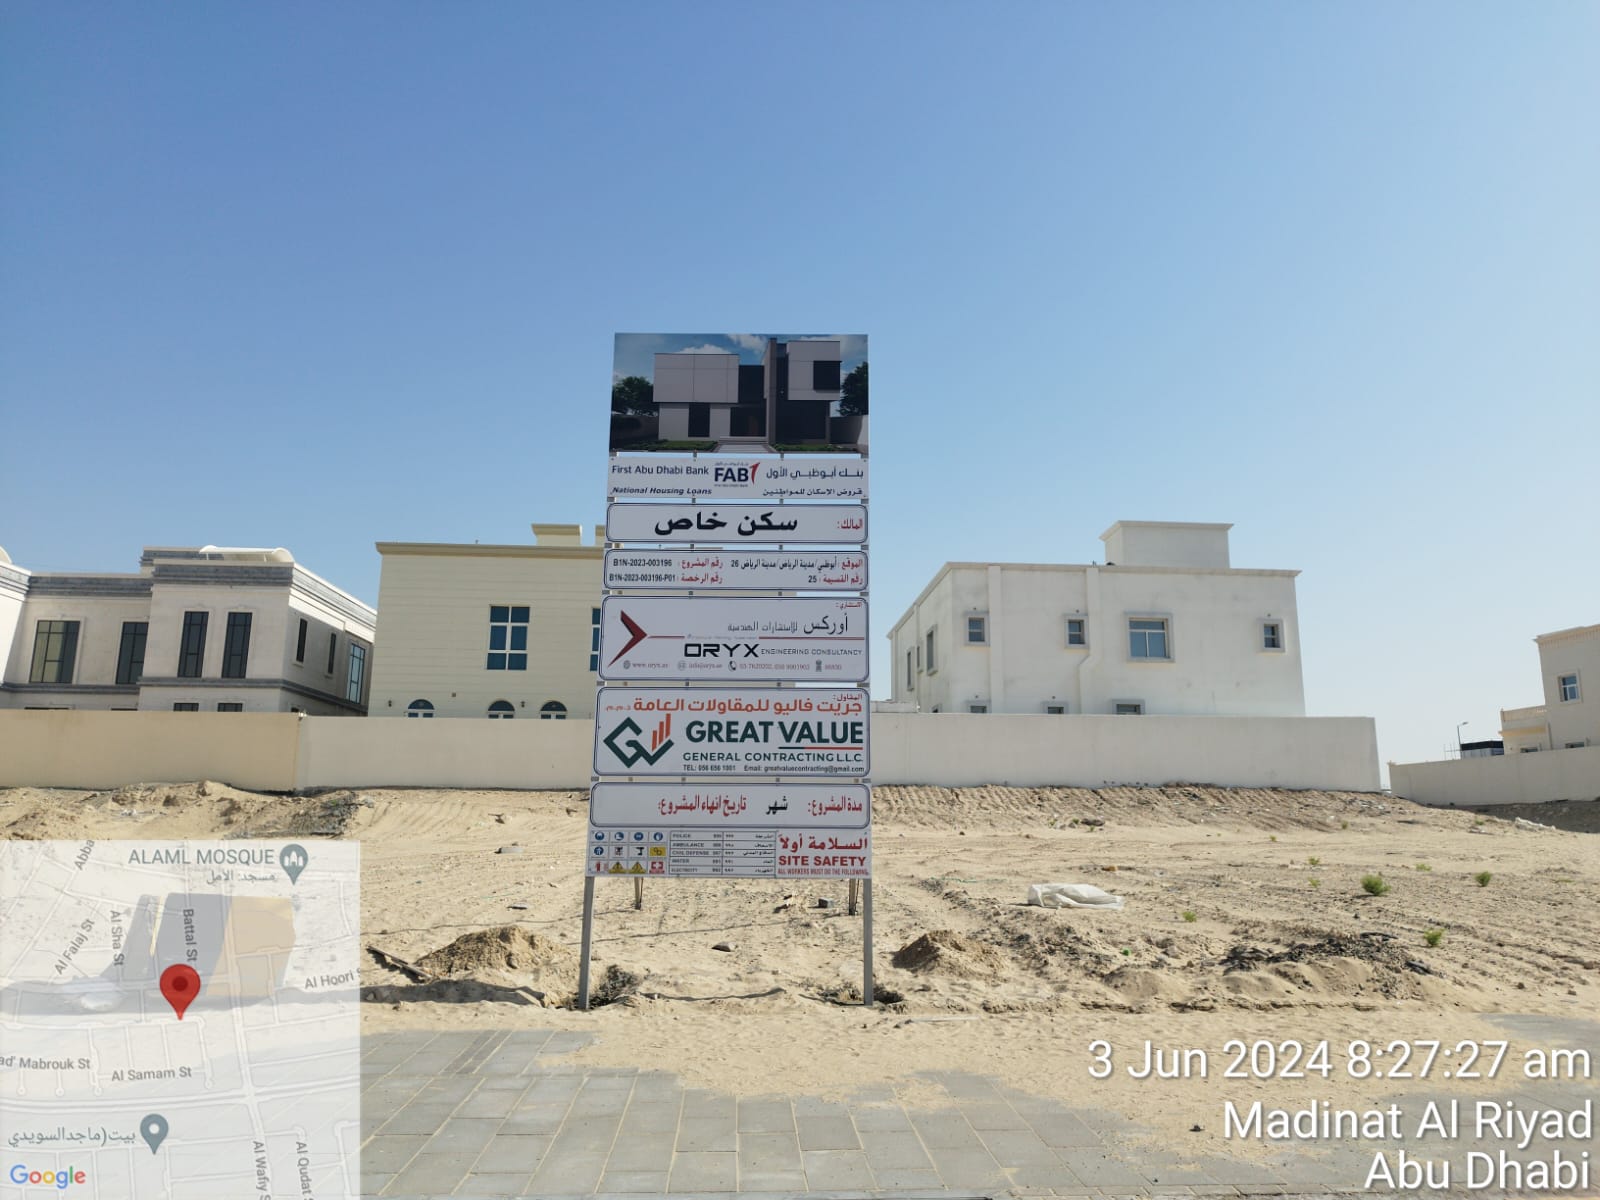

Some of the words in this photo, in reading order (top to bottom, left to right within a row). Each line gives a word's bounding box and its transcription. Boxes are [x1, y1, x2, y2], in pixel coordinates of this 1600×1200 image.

[611, 465, 632, 474] First
[634, 465, 654, 475] Abu
[656, 465, 683, 475] Dhabi
[686, 466, 709, 475] Bank
[766, 465, 788, 479] الأول
[838, 467, 864, 479] بنك
[612, 487, 647, 495] National
[649, 488, 685, 496] Housing
[687, 488, 712, 496] Loans
[836, 487, 863, 497] قروض
[654, 511, 727, 536] خاص
[737, 511, 798, 536] سكن
[730, 559, 739, 568] 26
[808, 575, 817, 584] 25
[803, 613, 848, 634] أوركس
[684, 643, 760, 658] ORYX
[633, 698, 684, 711] العامة
[688, 698, 769, 715] للمقاولات
[774, 698, 813, 715] فاليو
[817, 701, 862, 716] جريت
[685, 721, 774, 743] GREAT
[777, 721, 864, 744] VALUE
[682, 752, 741, 761] GENERAL
[744, 752, 833, 762] CONTRACTING
[723, 795, 747, 817] تاريخ
[765, 796, 788, 815] شهر
[847, 798, 862, 811] مدة
[808, 836, 868, 850] السلامة
[779, 856, 809, 866] SITE
[813, 856, 866, 867] SAFETY
